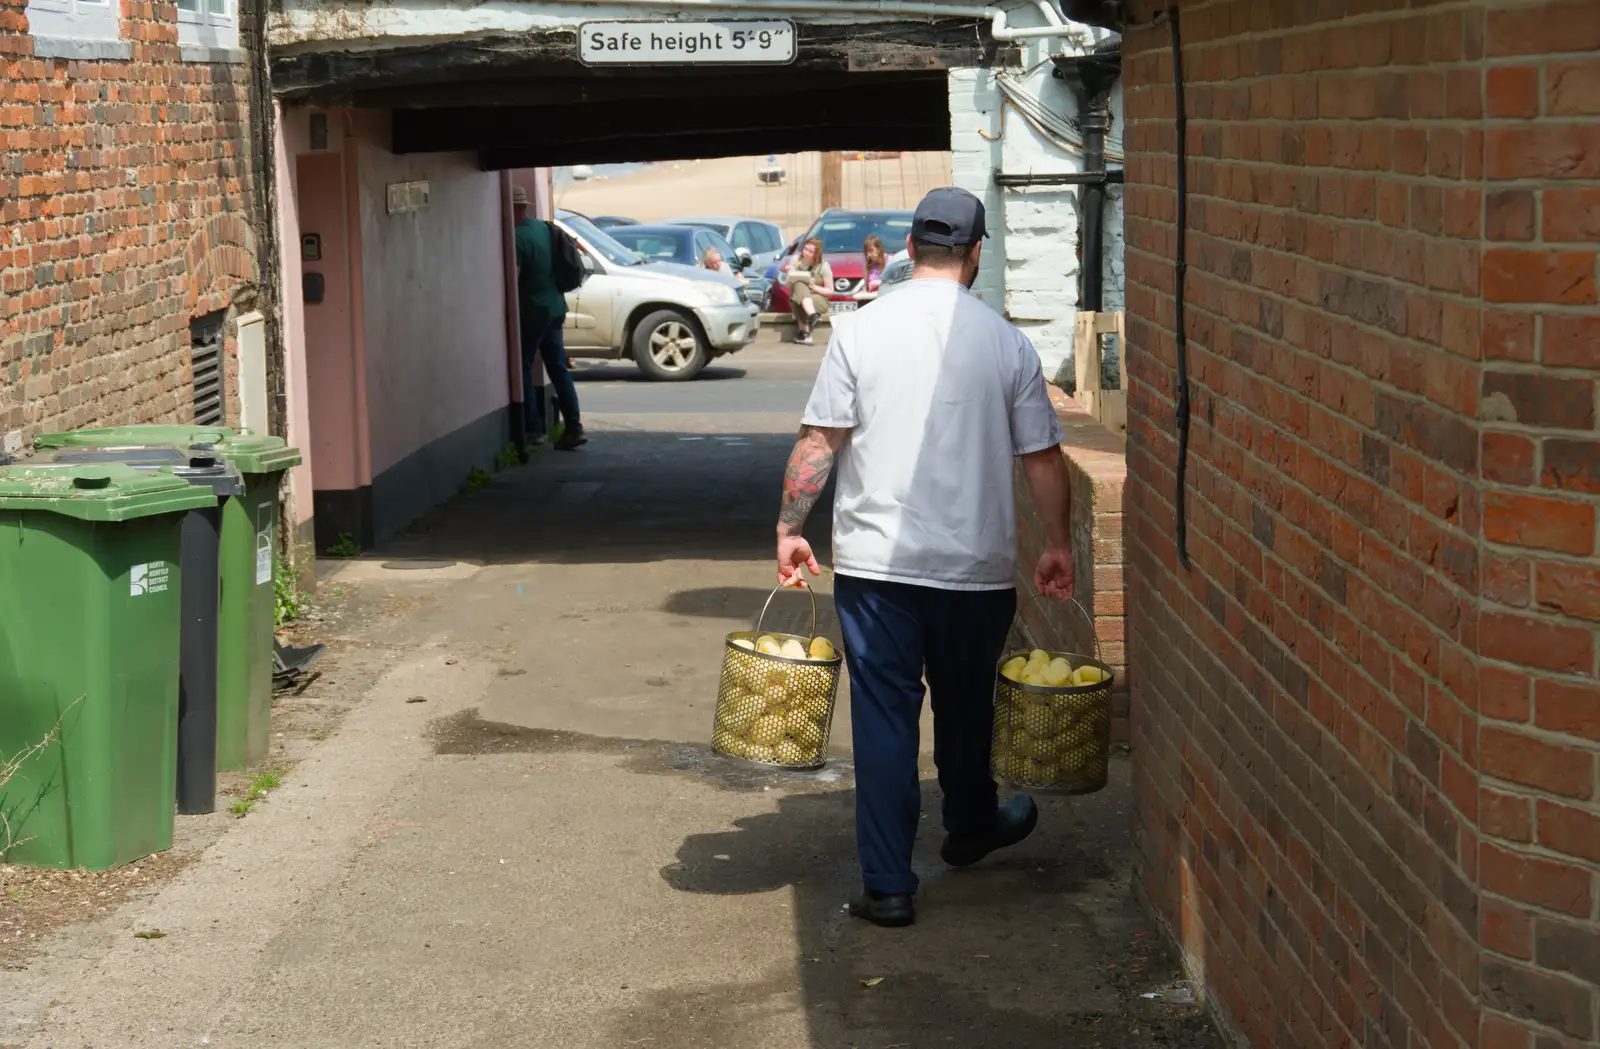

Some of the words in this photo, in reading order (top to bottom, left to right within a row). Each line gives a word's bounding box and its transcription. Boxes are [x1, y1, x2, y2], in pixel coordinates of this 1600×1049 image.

[590, 32, 642, 51] Safe
[650, 31, 722, 53] height
[149, 568, 168, 576] NORFOLK
[149, 575, 168, 585] DISTRICT
[149, 584, 168, 593] COUNCIL
